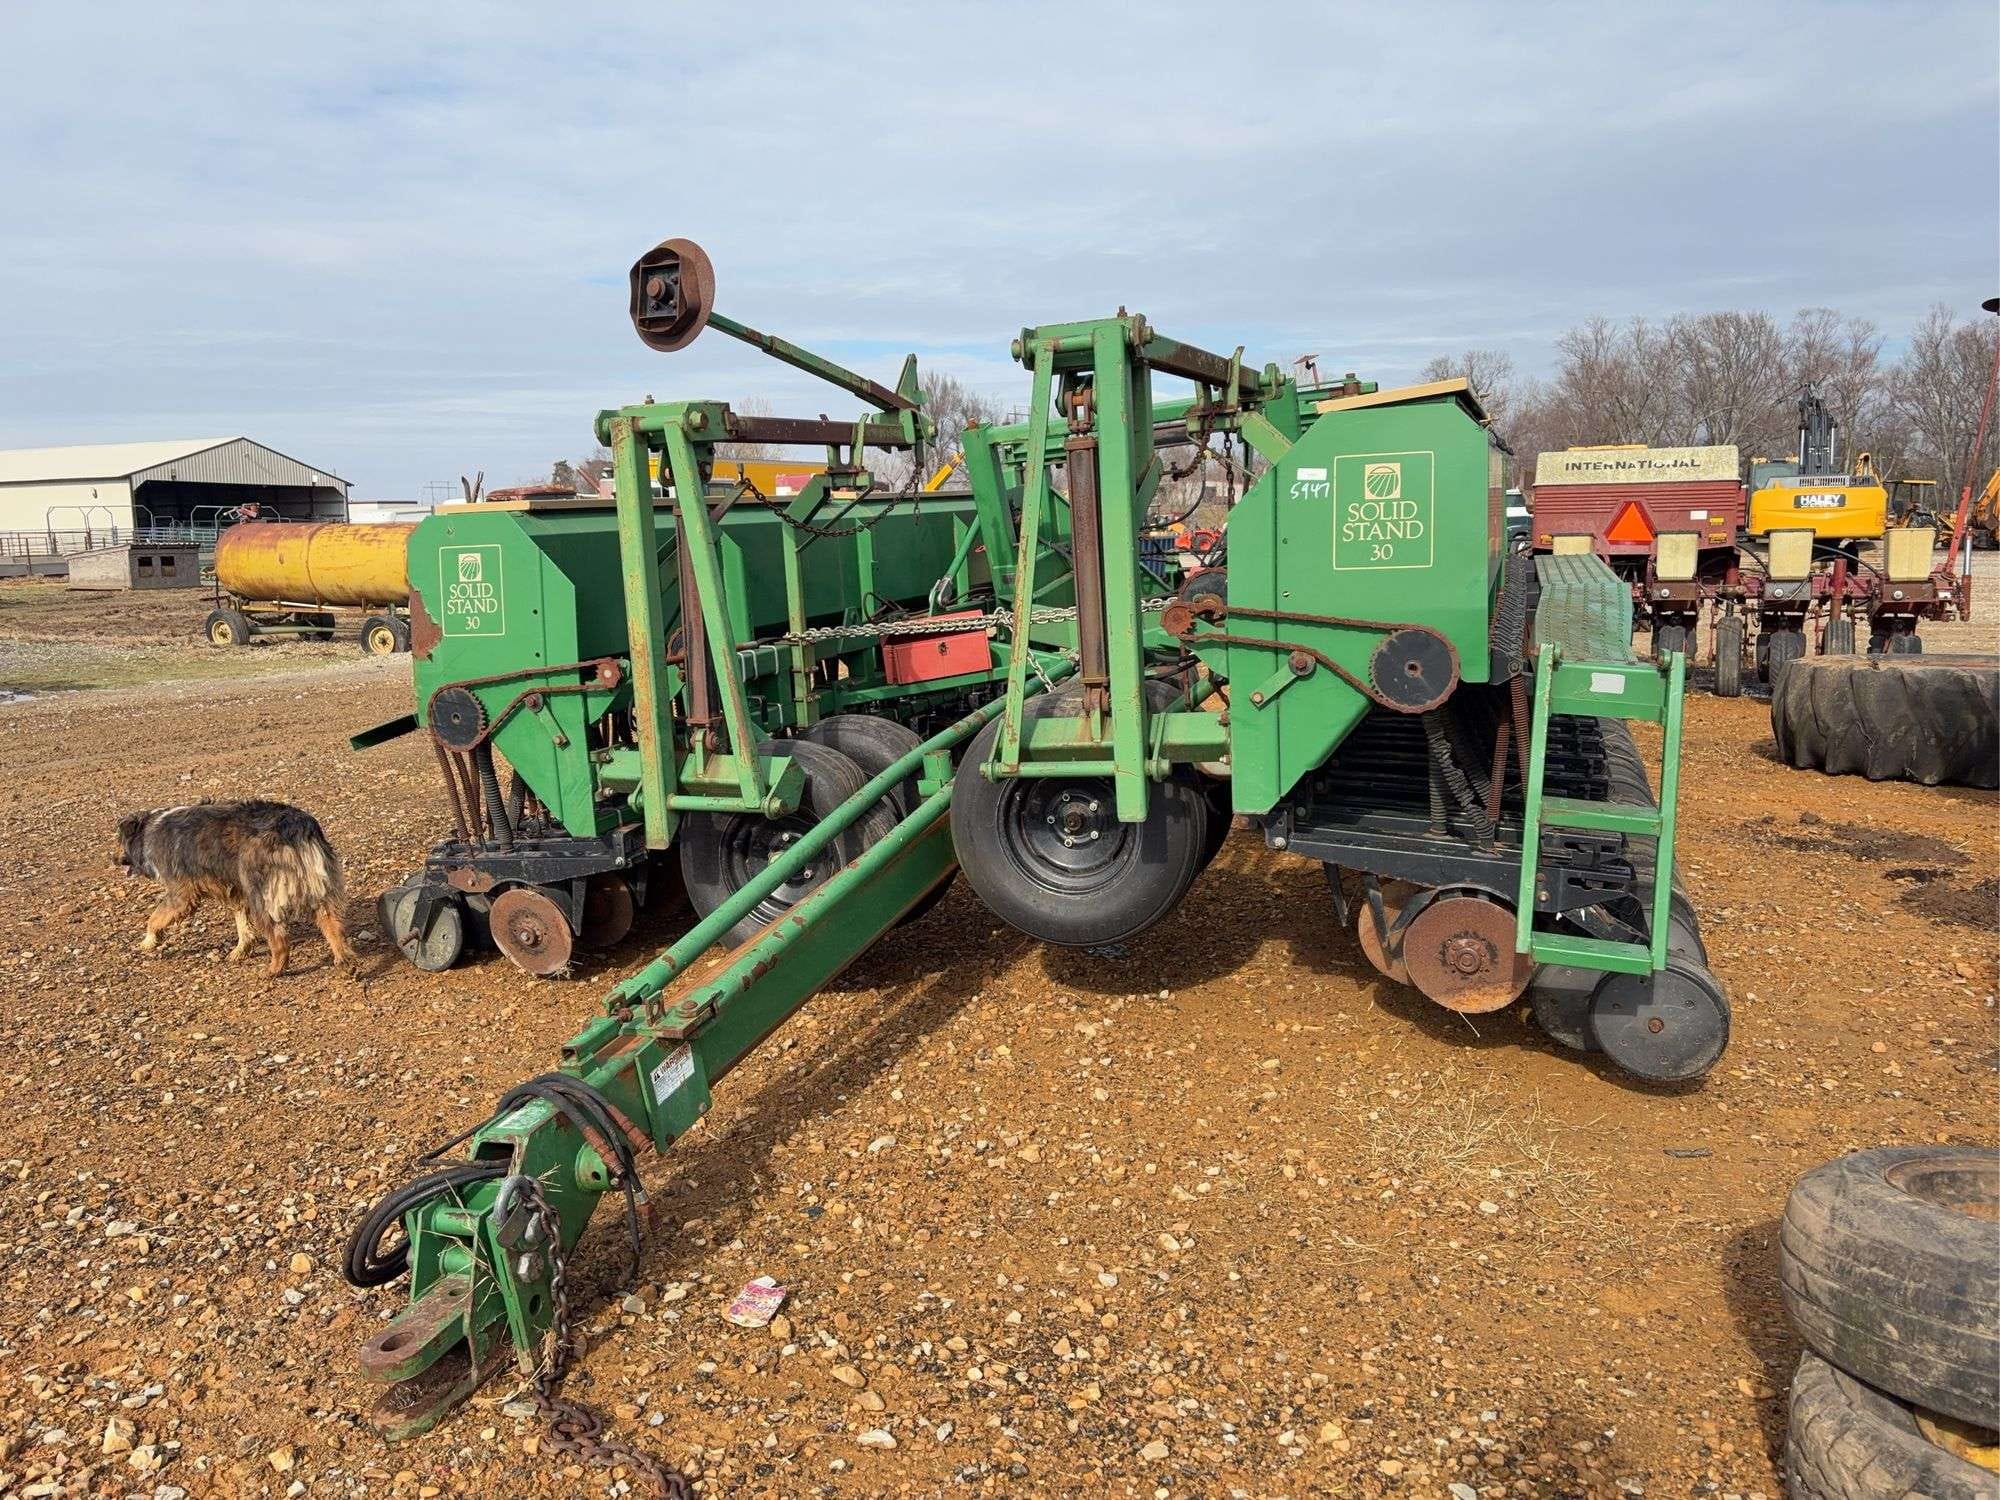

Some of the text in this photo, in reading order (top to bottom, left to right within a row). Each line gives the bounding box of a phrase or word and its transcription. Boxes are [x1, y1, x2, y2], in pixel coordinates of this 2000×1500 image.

[1290, 481, 1330, 500] 5947
[1800, 494, 1841, 506] HALEY
[1348, 500, 1418, 522] SOLID
[1342, 520, 1424, 542] STAND
[1370, 543, 1393, 561] 30
[449, 582, 494, 599] SOLID
[447, 598, 498, 615] STAND
[465, 616, 480, 630] 30
